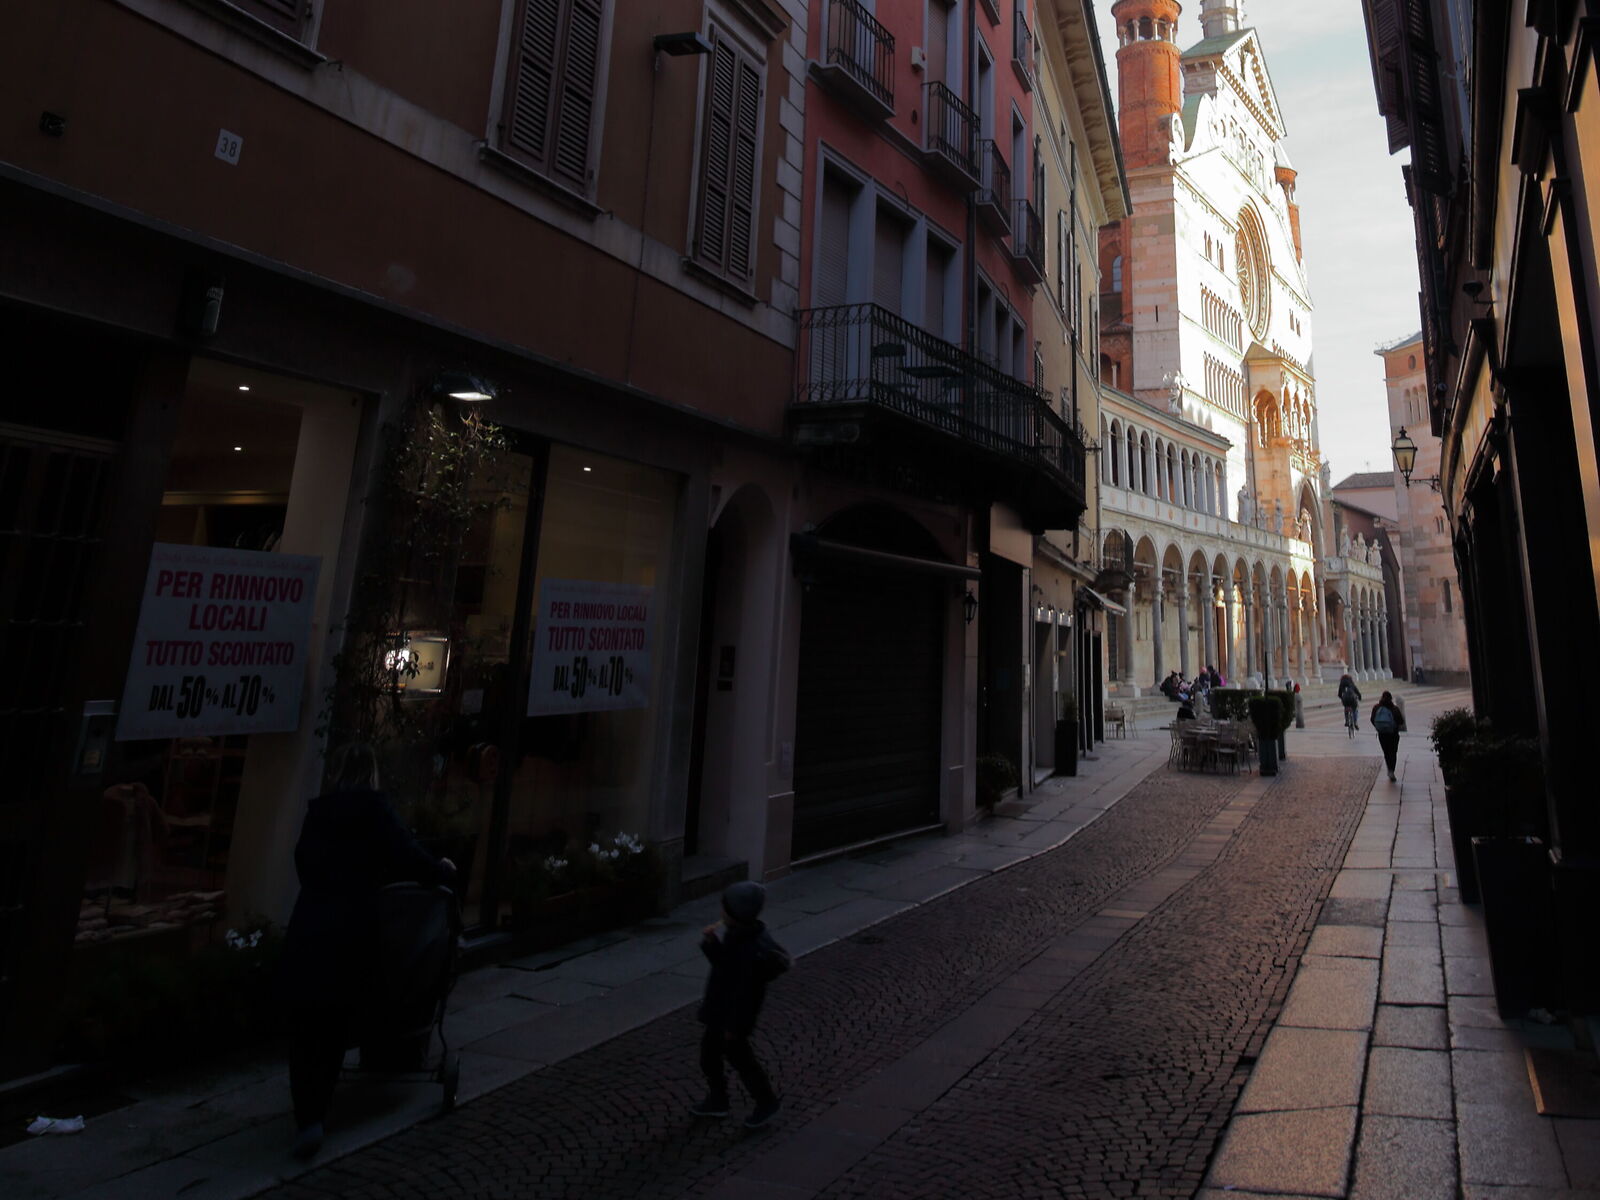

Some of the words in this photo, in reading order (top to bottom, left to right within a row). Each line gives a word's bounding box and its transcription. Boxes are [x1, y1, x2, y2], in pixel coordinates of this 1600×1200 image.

[220, 137, 237, 157] 38
[155, 569, 204, 598] PER
[209, 573, 304, 603] RINNOVO
[188, 604, 267, 631] LOCALI
[550, 602, 570, 619] PER
[573, 602, 615, 620] RINNOVO
[617, 605, 647, 621] LOCALI
[548, 626, 585, 651] TUTTO
[588, 627, 645, 651] SCONTATO
[146, 640, 204, 666] TUTTO
[207, 641, 295, 666] SCONTATO
[553, 665, 569, 691] DAL
[598, 664, 608, 689] AL
[148, 684, 174, 712] DAL
[221, 683, 237, 709] AL
